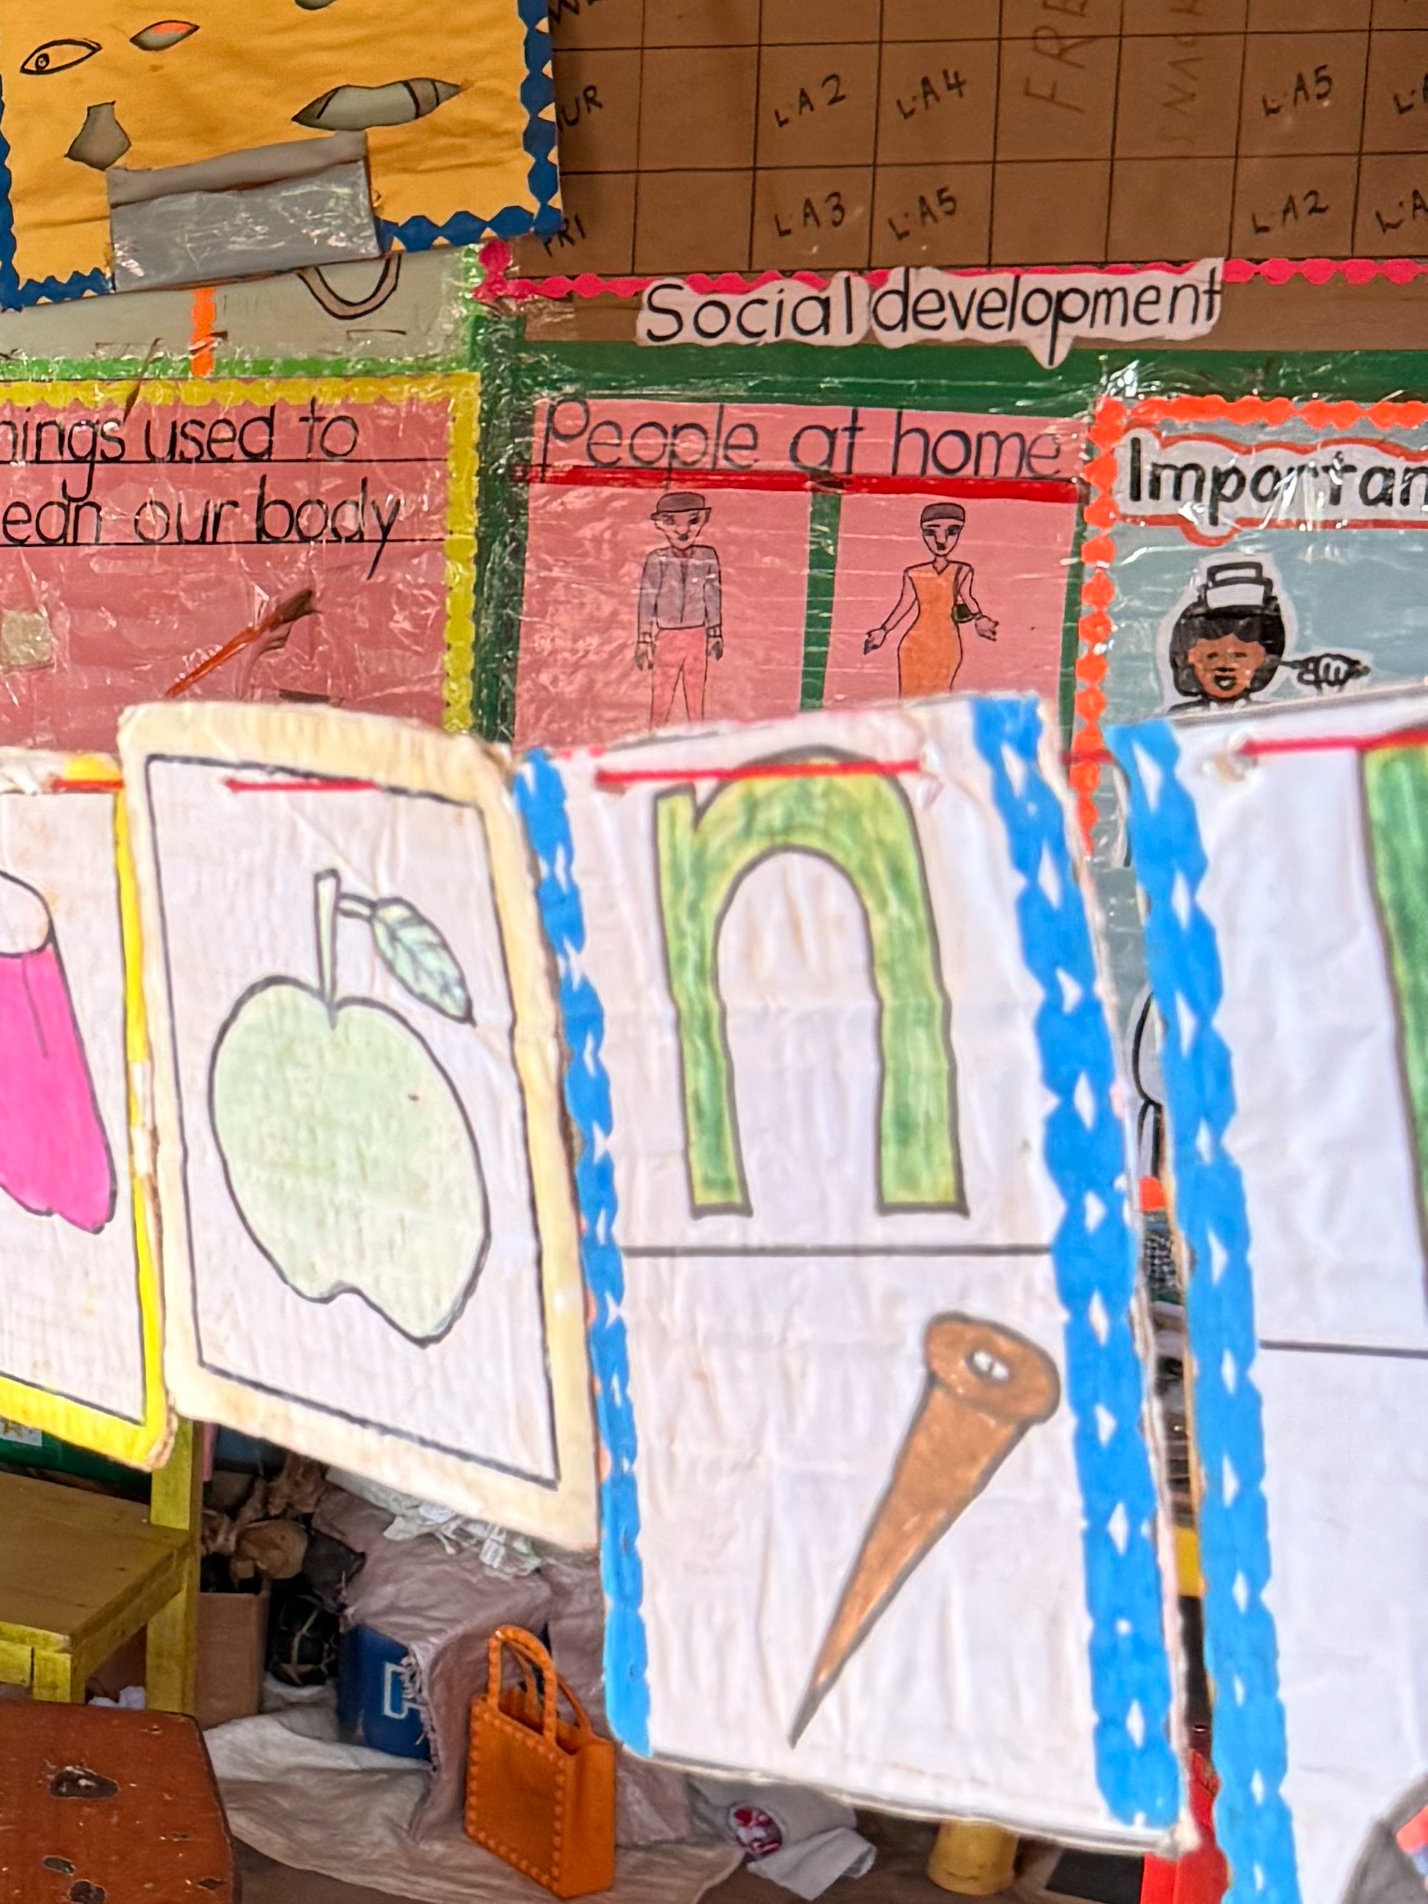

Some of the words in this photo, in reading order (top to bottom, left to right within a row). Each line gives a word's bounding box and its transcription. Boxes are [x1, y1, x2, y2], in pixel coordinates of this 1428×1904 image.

[645, 276, 854, 343] Social
[871, 266, 1222, 366] development
[144, 405, 276, 462] used
[298, 396, 360, 462] to
[540, 397, 760, 487] People
[789, 406, 865, 475] at
[891, 406, 1061, 478] home
[133, 498, 239, 545] our
[255, 474, 402, 581] body
